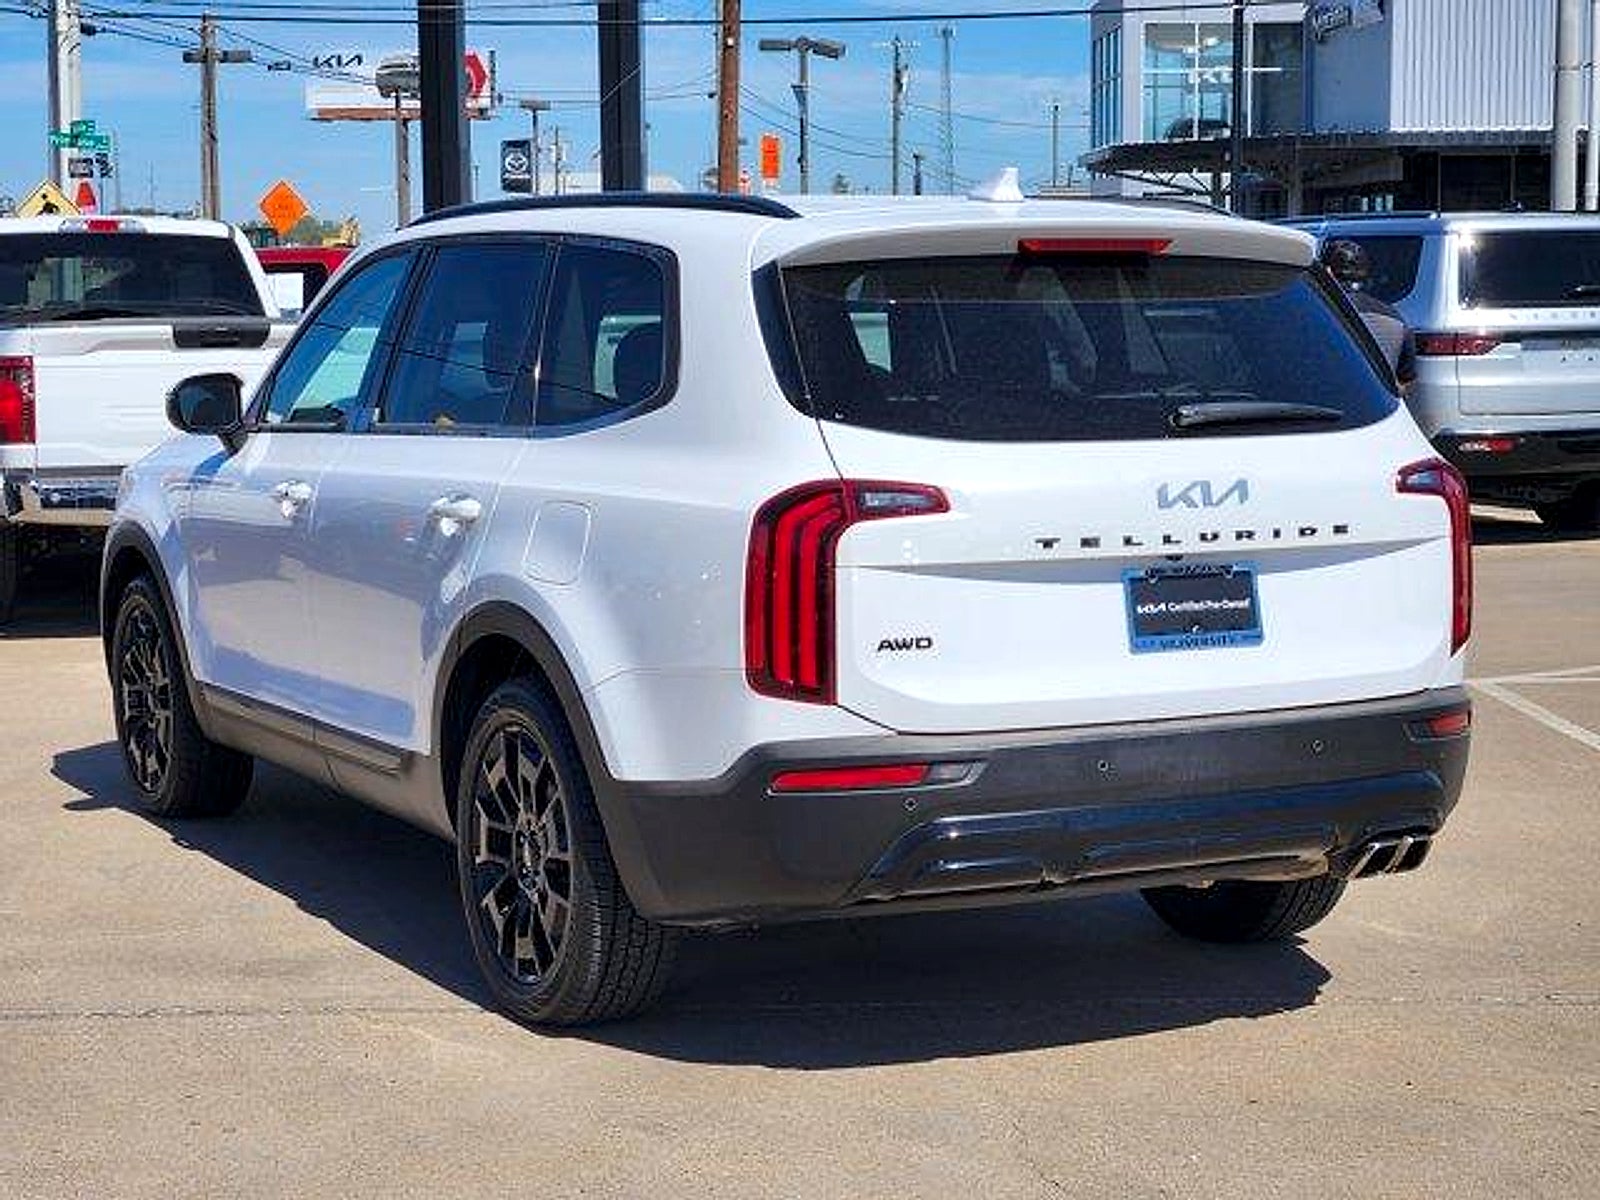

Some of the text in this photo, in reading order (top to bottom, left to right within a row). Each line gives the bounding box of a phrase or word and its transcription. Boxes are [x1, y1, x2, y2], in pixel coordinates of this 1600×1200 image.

[312, 53, 363, 69] KIA
[1156, 477, 1249, 509] KIA
[1035, 523, 1350, 550] TELLURIDE
[877, 637, 934, 652] AWD
